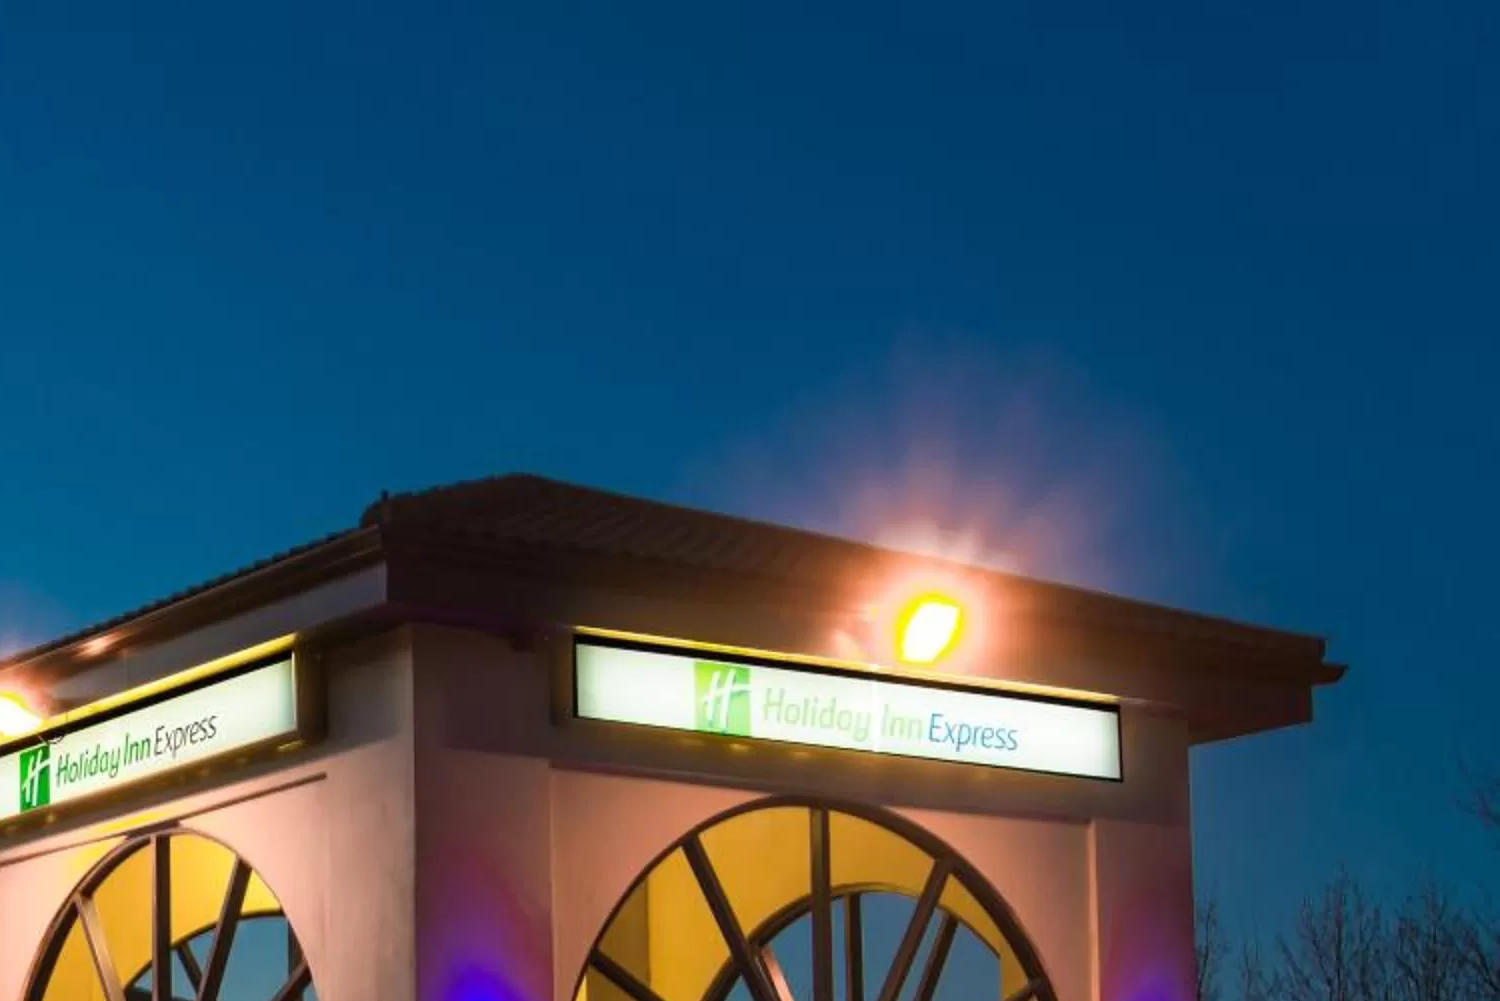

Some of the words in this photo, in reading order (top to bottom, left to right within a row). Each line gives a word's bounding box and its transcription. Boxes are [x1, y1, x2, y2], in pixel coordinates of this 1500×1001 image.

[56, 742, 121, 787] Holiday
[122, 733, 152, 768] Inn
[154, 715, 218, 757] Express
[761, 687, 871, 743] Holiday
[880, 703, 923, 741] Inn
[928, 713, 1019, 752] Express
